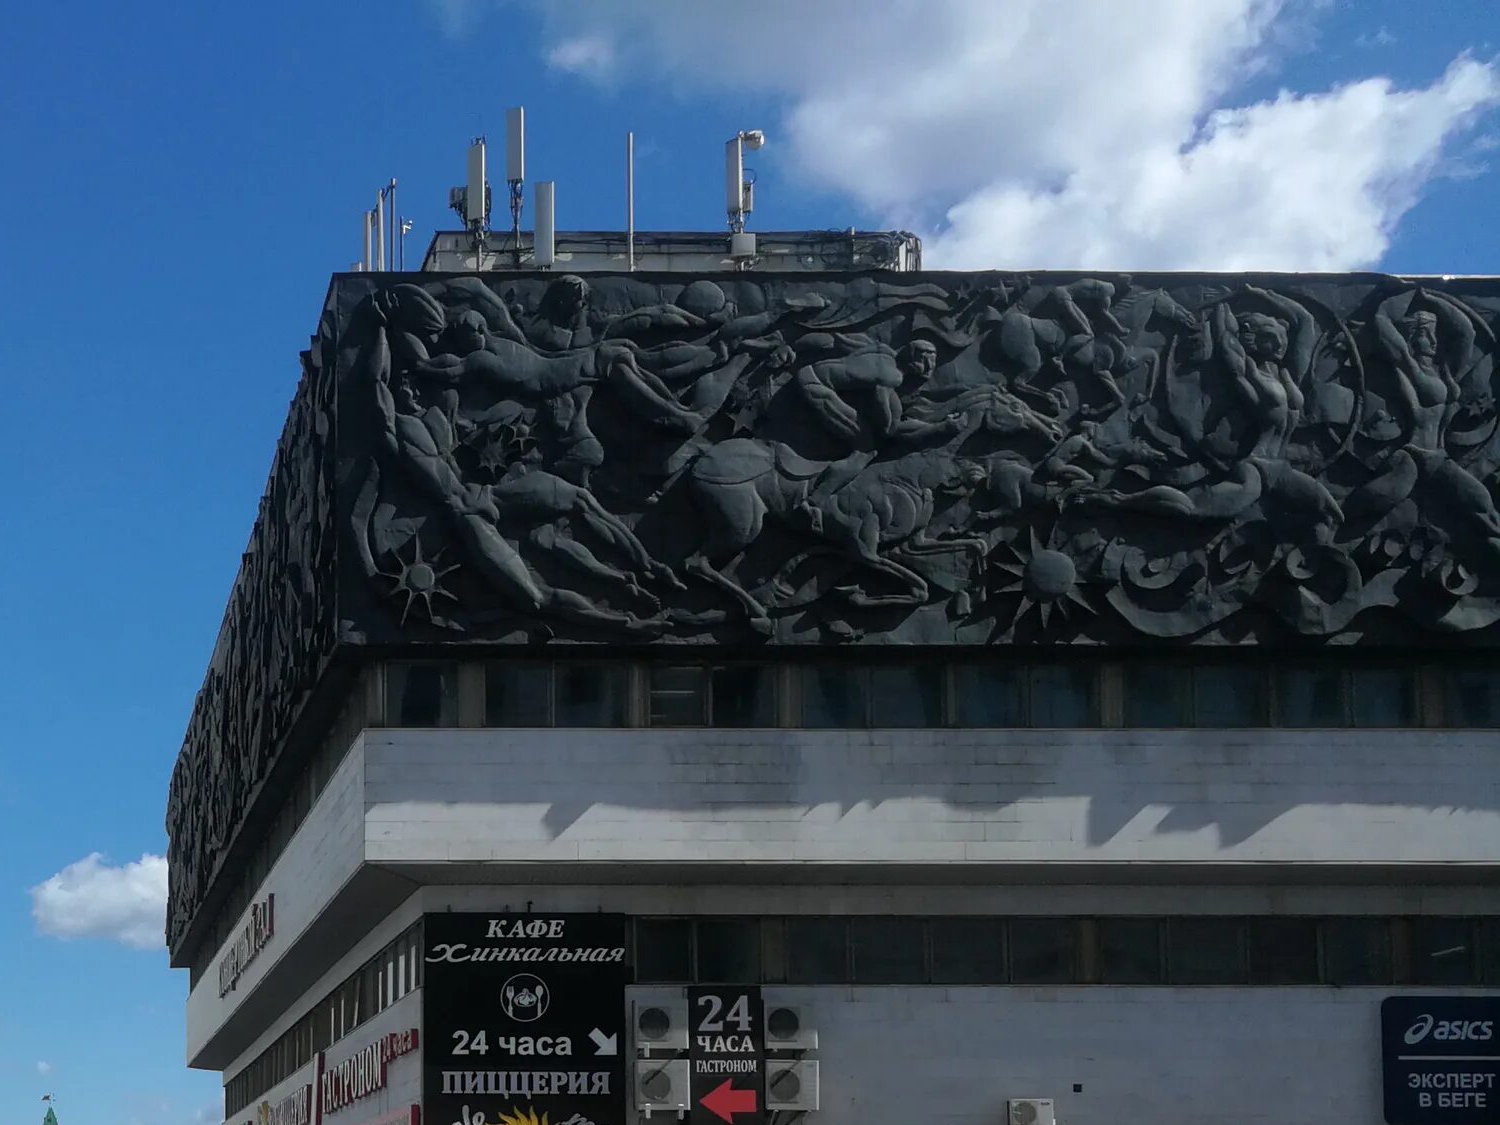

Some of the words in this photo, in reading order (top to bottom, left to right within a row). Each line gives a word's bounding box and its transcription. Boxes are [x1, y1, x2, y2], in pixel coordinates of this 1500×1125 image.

[485, 919, 565, 938] КАФЕ
[425, 943, 625, 963] Хинкальная
[698, 995, 752, 1031] 24
[1433, 1020, 1494, 1040] asics
[381, 1035, 392, 1063] 24
[392, 1029, 417, 1057] часа
[452, 1030, 489, 1055] 24
[499, 1036, 572, 1056] часа
[697, 1035, 755, 1053] ЧАСА
[696, 1059, 757, 1073] ГАСТРОНОМ
[322, 1039, 385, 1115] ГАСТРОНОМ
[442, 1071, 611, 1099] ПИЦЦЕРИЯ
[1408, 1073, 1496, 1088] ЭКСПЕРТ
[1419, 1092, 1432, 1107] В
[1438, 1092, 1487, 1108] БЕГЕ
